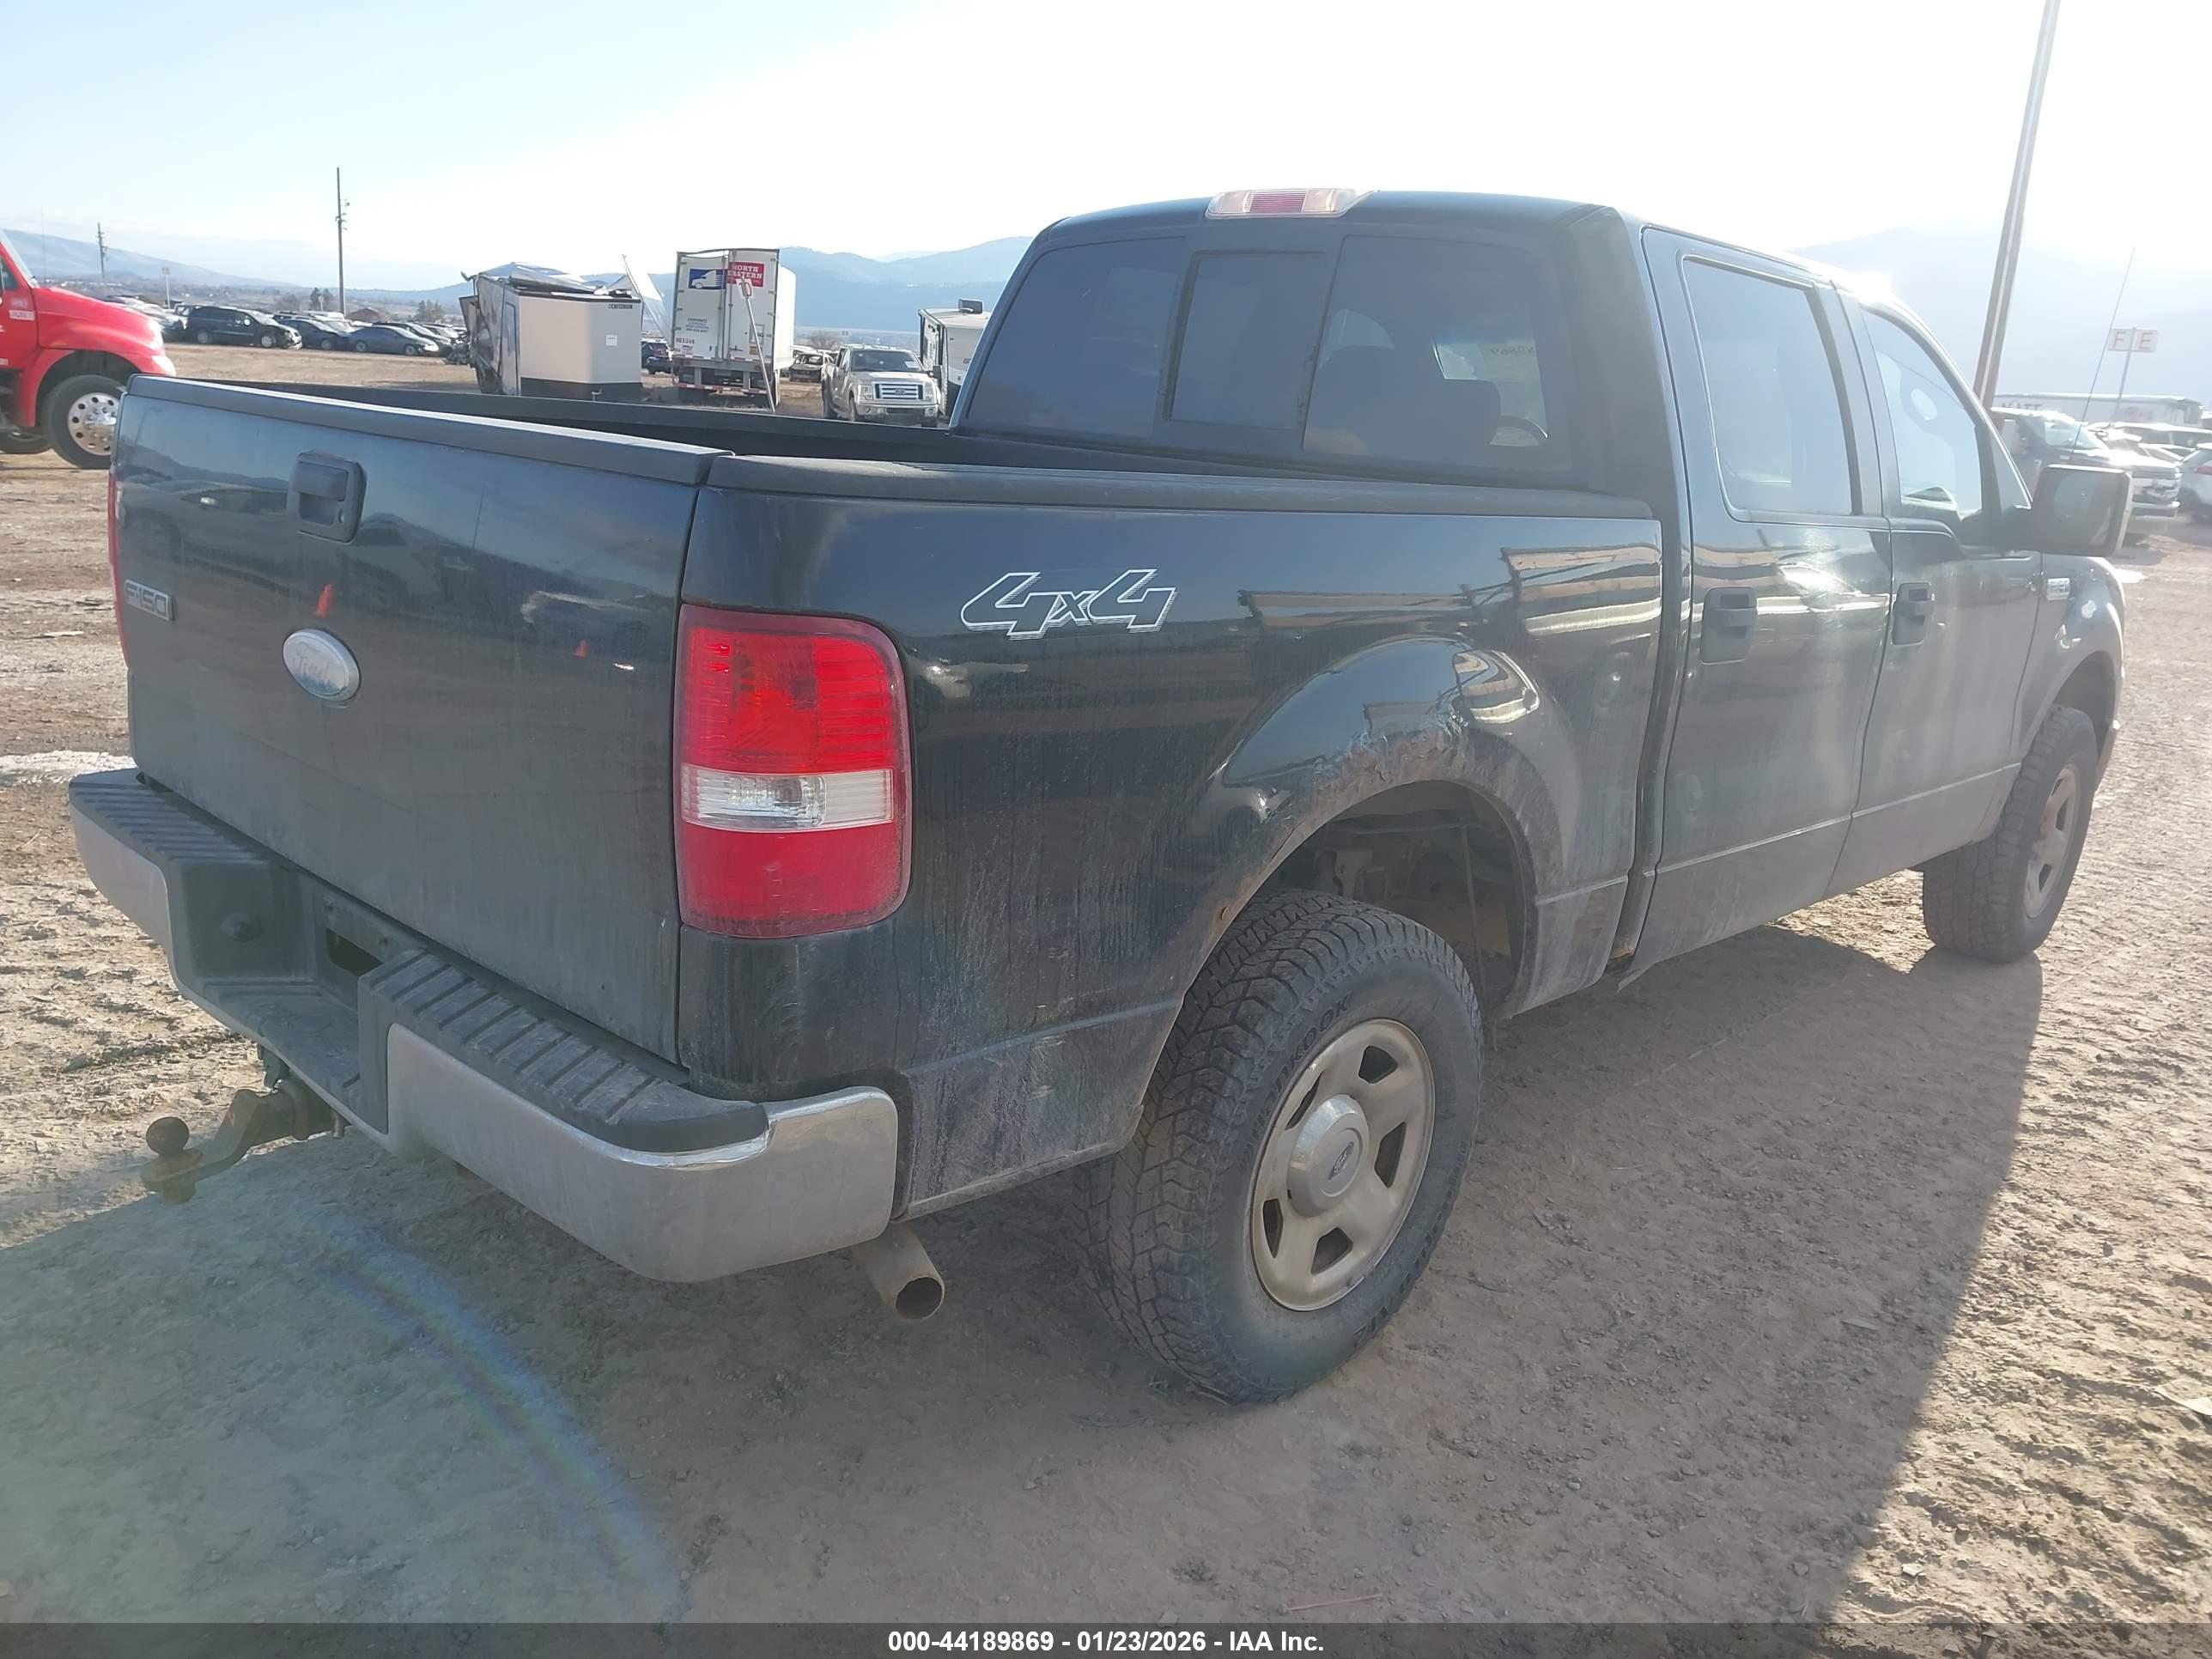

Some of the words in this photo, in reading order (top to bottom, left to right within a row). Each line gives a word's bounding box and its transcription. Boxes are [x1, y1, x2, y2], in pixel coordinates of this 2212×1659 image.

[727, 270, 763, 279] EASTERN
[732, 264, 759, 273] NORTH
[2112, 331, 2127, 349] F
[2138, 331, 2154, 350] E
[960, 568, 1177, 641] 4x4
